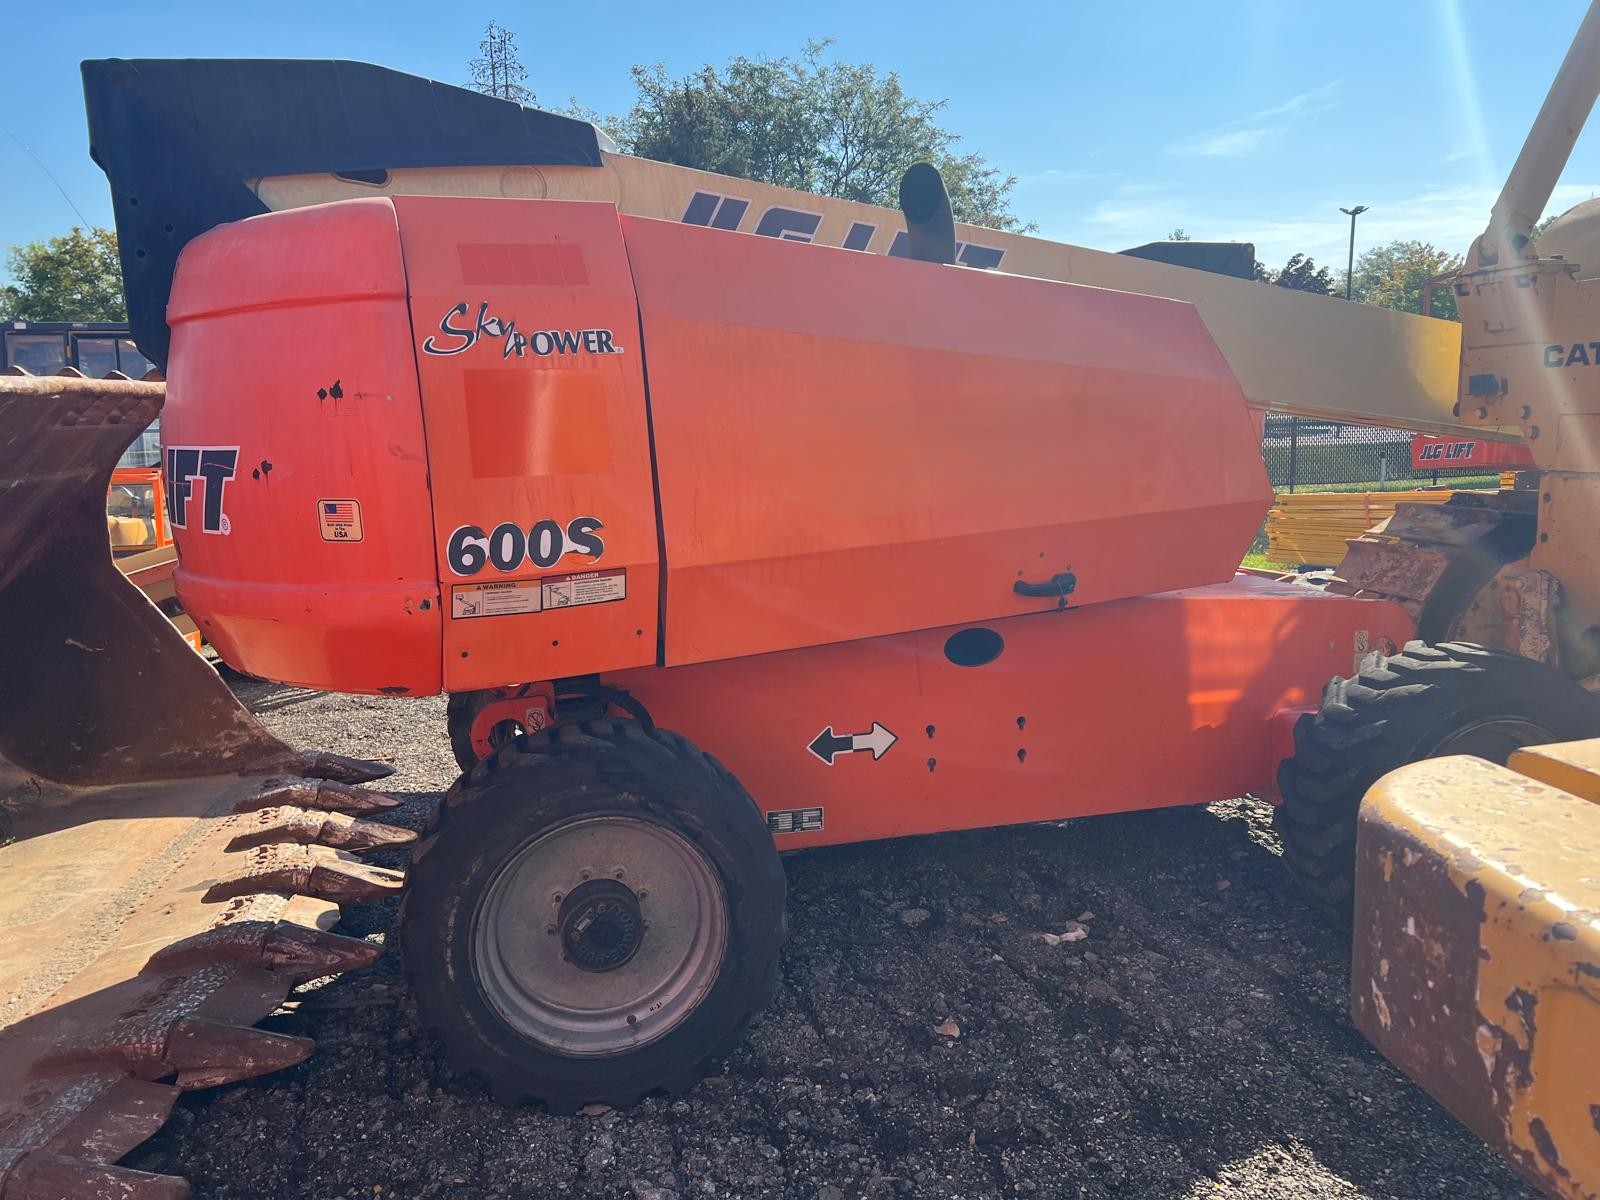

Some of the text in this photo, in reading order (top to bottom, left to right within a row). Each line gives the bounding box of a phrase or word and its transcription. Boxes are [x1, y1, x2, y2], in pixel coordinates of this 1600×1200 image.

[1420, 442, 1476, 460] JLG LIFT
[447, 516, 604, 577] 600S
[571, 572, 599, 581] DANGER
[483, 582, 516, 592] WARNING
